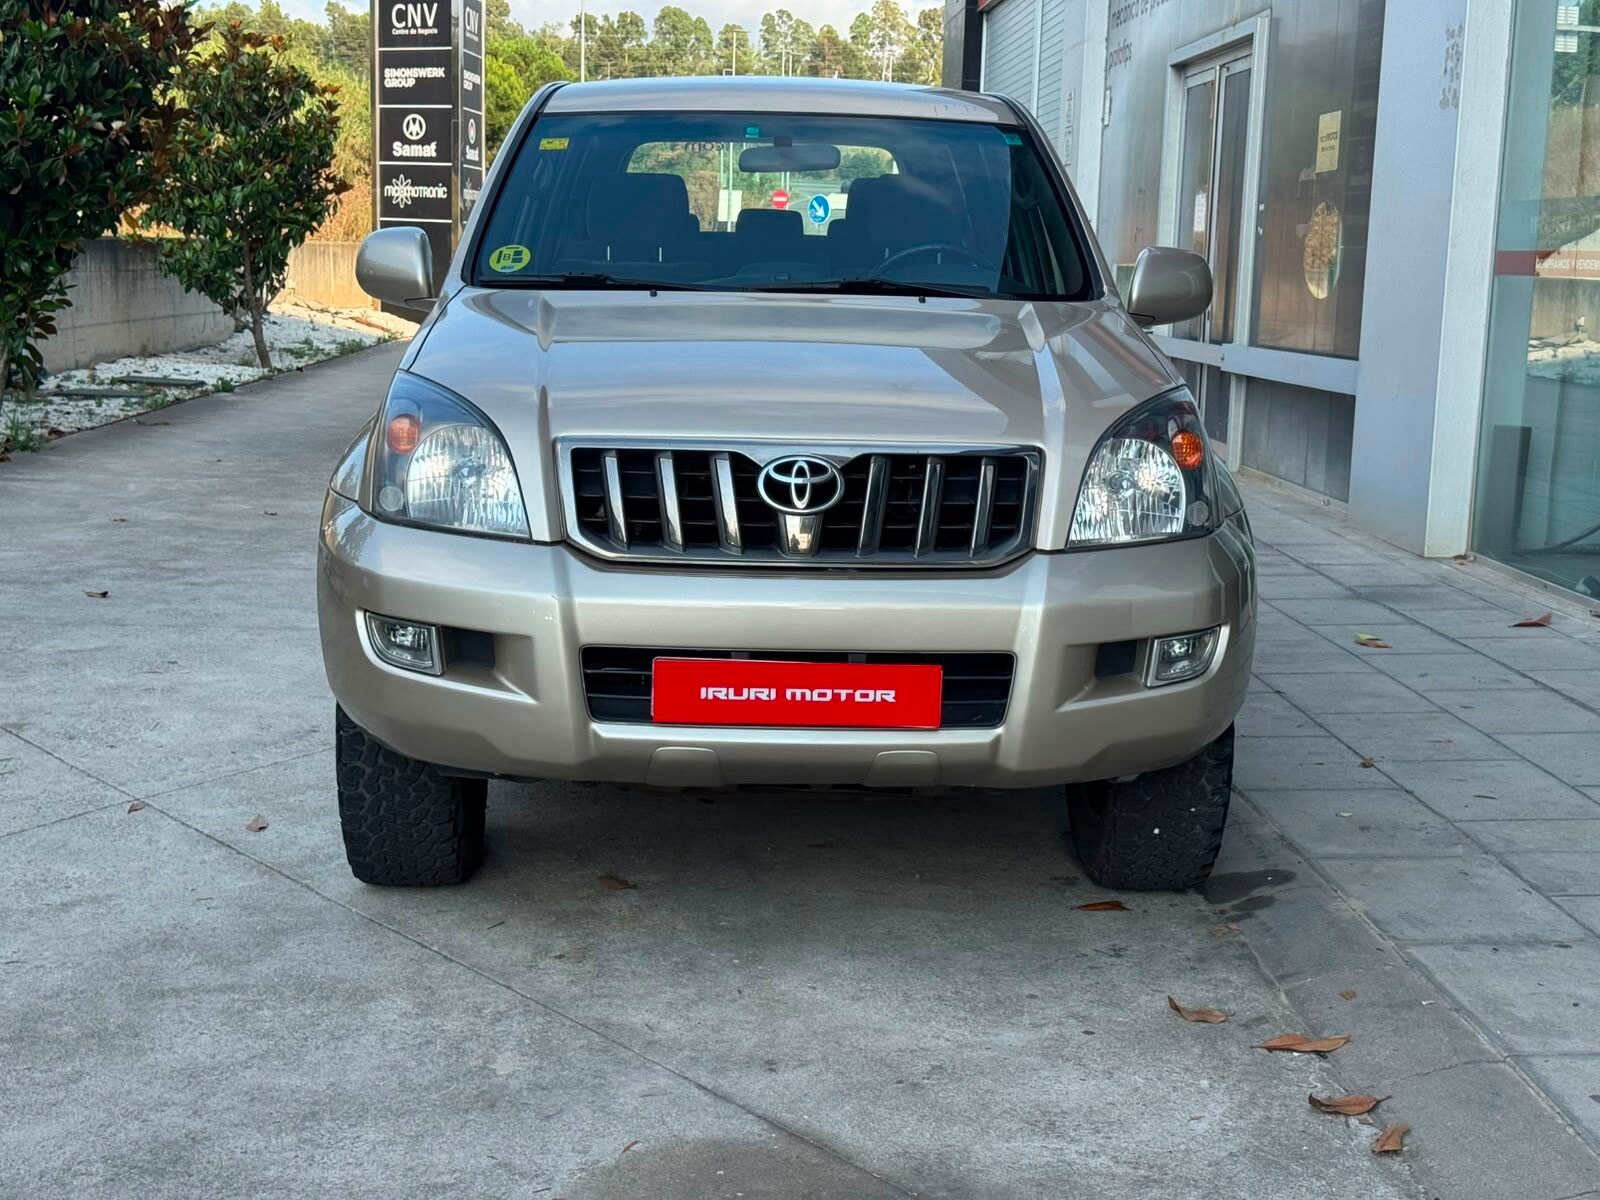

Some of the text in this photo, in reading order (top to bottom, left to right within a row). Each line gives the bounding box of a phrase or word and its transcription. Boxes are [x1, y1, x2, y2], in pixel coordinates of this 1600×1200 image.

[391, 2, 438, 28] CNV
[384, 67, 445, 78] SIMONSWERK
[384, 78, 416, 88] GROUP
[392, 141, 437, 157] Samat
[700, 687, 896, 702] IRURI MOTOR
